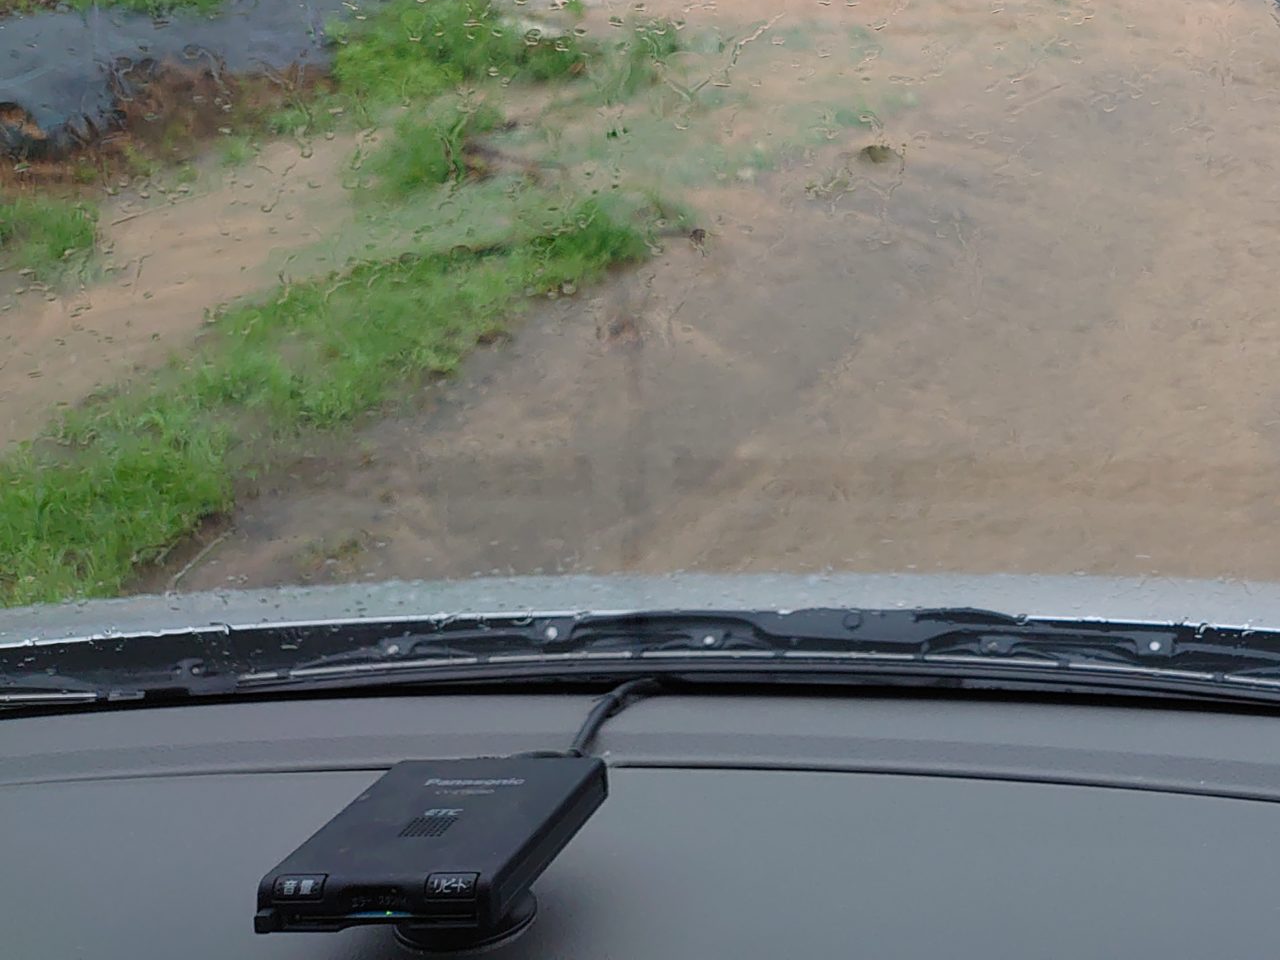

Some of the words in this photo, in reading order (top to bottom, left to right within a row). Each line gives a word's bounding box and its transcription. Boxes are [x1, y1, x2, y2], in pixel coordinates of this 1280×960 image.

[424, 777, 526, 786] Panasonic
[424, 808, 464, 816] ETC
[283, 879, 314, 895] 音量
